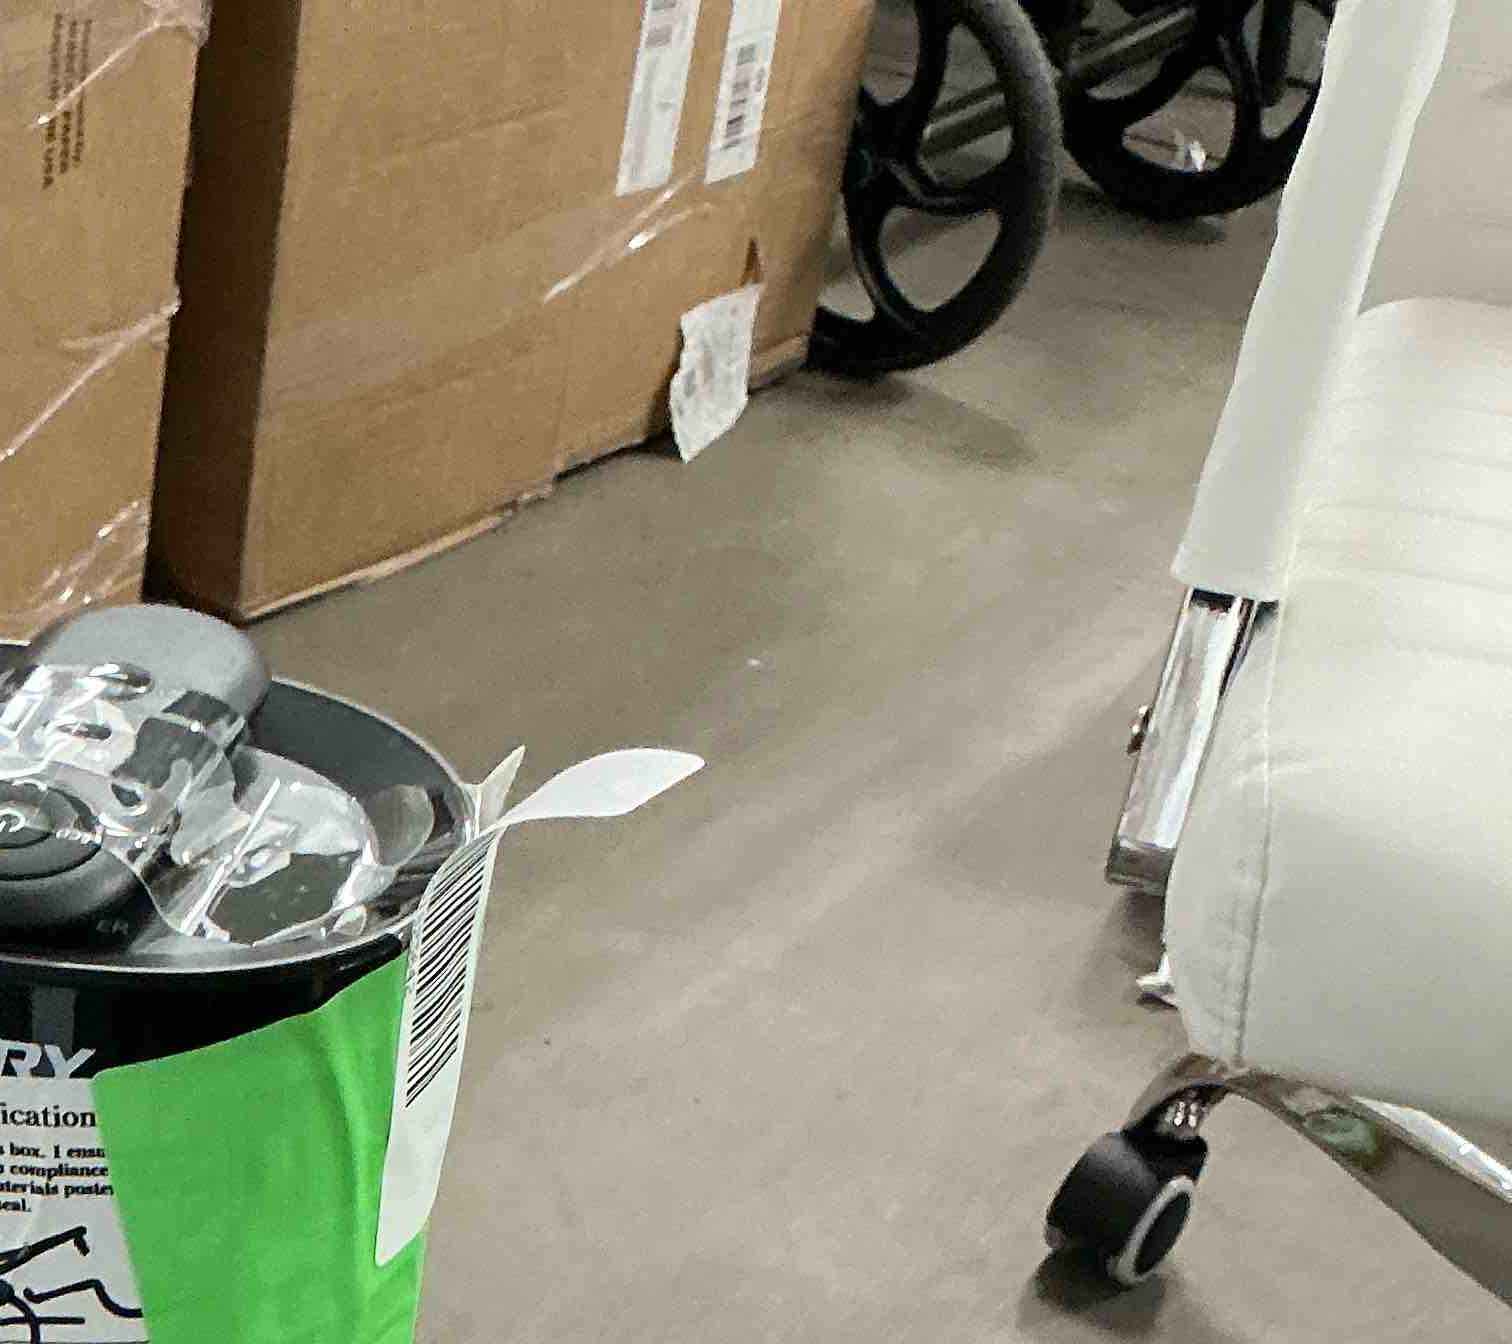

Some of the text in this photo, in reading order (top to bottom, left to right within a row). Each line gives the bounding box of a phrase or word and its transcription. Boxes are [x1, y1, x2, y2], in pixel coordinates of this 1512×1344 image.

[9, 1142, 46, 1158] box.
[53, 1144, 61, 1159] I
[9, 1163, 109, 1181] compliance
